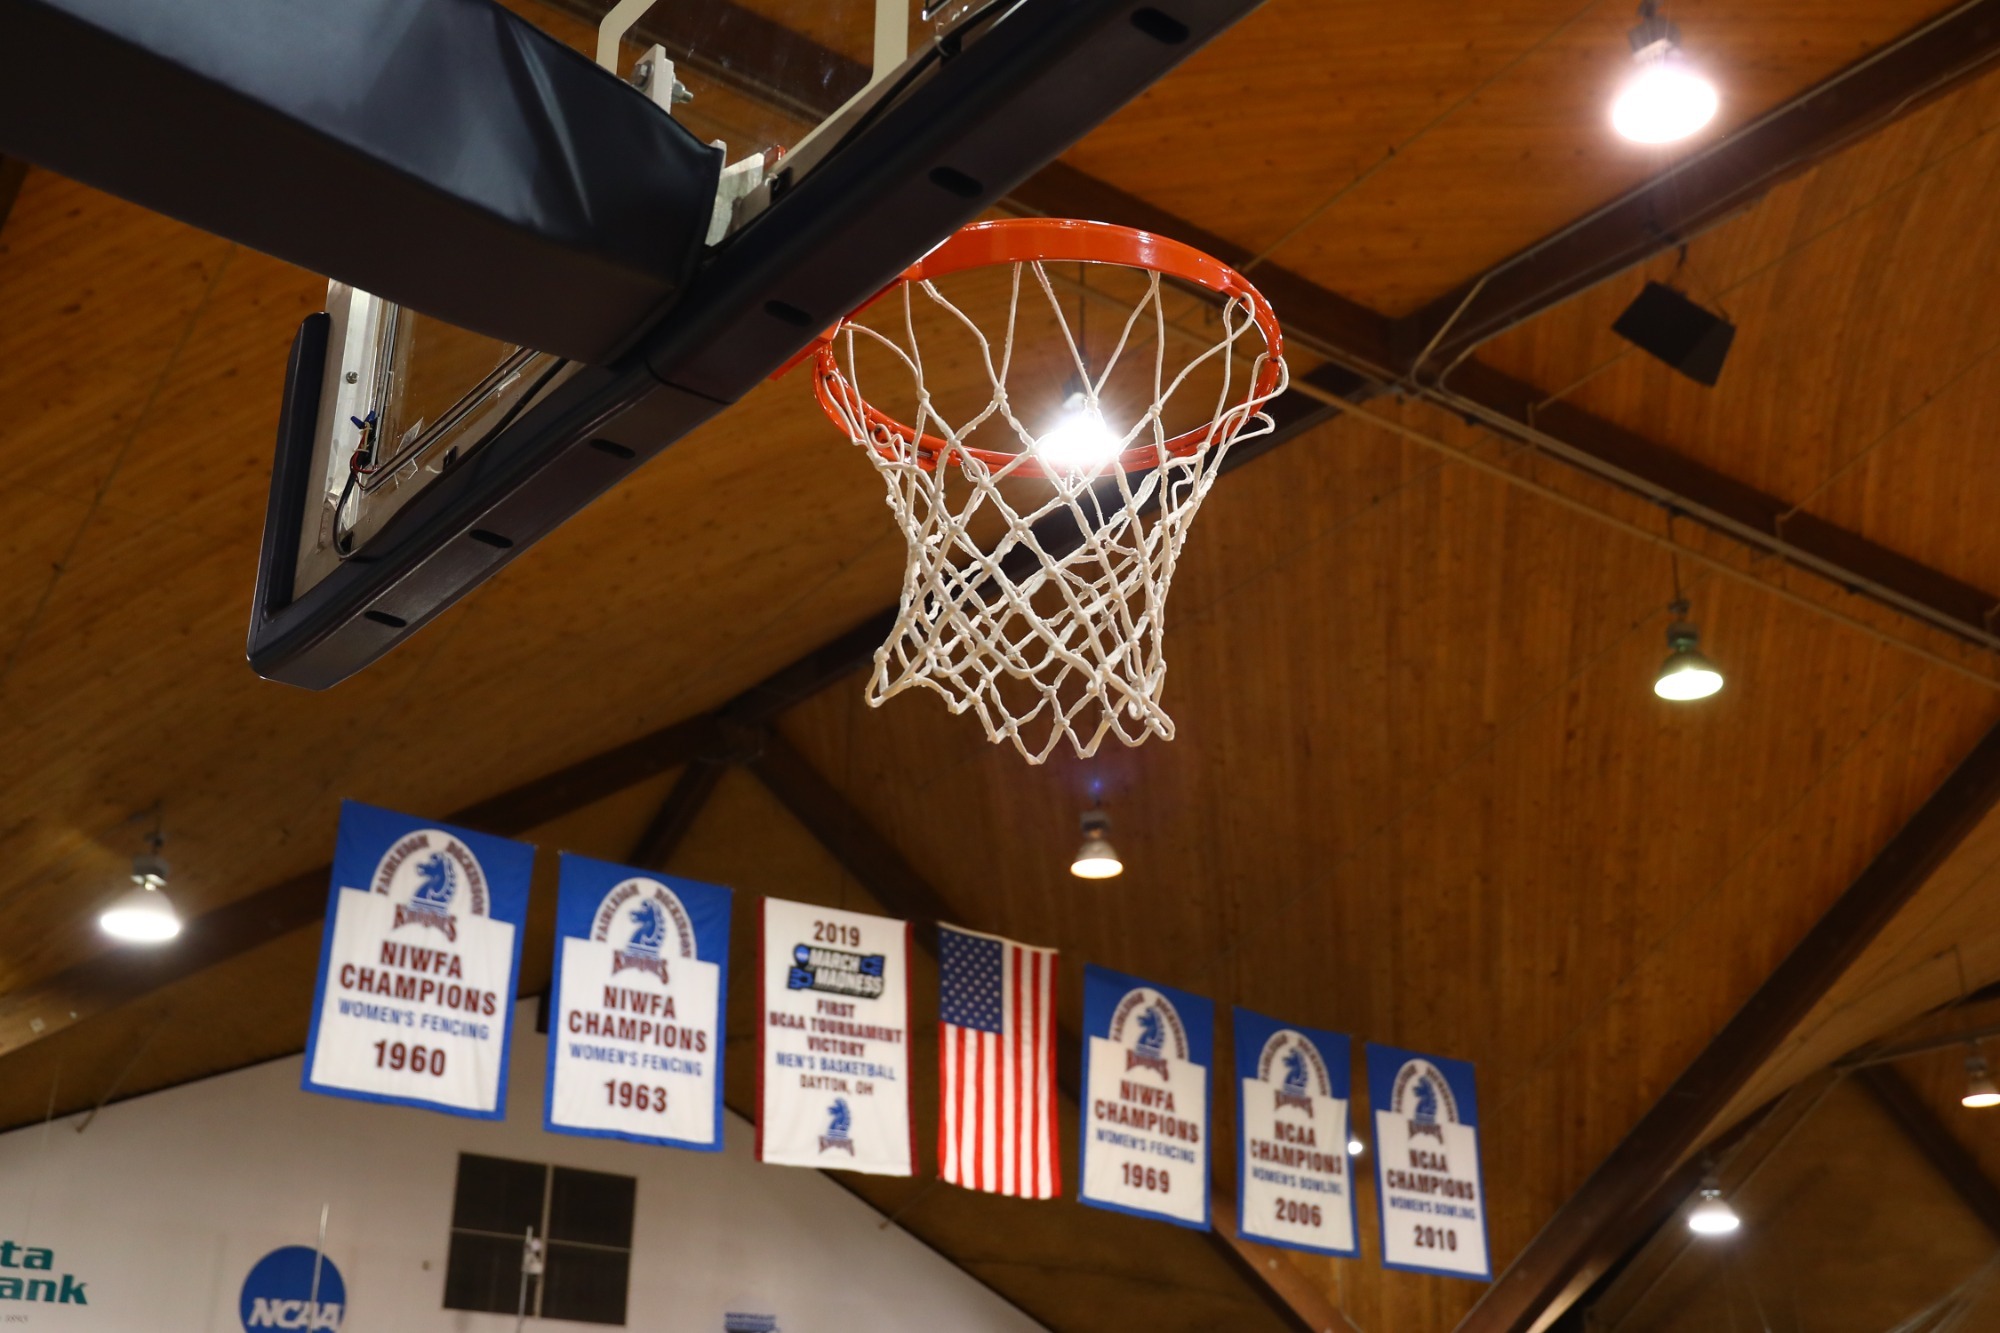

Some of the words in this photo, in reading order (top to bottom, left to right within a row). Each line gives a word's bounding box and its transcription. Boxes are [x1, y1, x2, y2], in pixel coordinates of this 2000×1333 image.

[813, 920, 860, 947] 2019
[380, 941, 463, 979] NIWFA
[809, 948, 861, 974] MARCH
[340, 964, 497, 1017] CHAMPIONS
[814, 968, 883, 994] MADNESS
[603, 985, 676, 1019] NIWFA
[817, 999, 856, 1018] FIRST
[338, 998, 415, 1027] WOMEN'S
[420, 1013, 489, 1040] FENCING
[568, 1010, 707, 1053] CHAMPIONS
[769, 1011, 806, 1031] NCAA
[810, 1017, 902, 1043] TOURNAMENT
[374, 1039, 446, 1078] 1960
[569, 1043, 638, 1067] WOMEN'S
[642, 1055, 703, 1077] FENCING
[807, 1035, 865, 1058] VICTORY
[776, 1051, 815, 1069] MEN'S
[820, 1056, 896, 1081] BASKETBALL
[604, 1079, 667, 1114] 1963
[800, 1074, 851, 1095] DAYTON,
[855, 1081, 874, 1096] OH
[1119, 1080, 1175, 1113] NIWFA
[1094, 1099, 1199, 1144] CHAMPIONS
[1274, 1121, 1316, 1147] NCAA
[1096, 1128, 1147, 1152] WOMEN'S
[1150, 1141, 1195, 1164] FENCING
[1250, 1139, 1342, 1175] CHAMPIONS
[1408, 1148, 1448, 1173] NCAA
[1121, 1162, 1170, 1194] 1969
[1252, 1166, 1298, 1188] WOMEN'S
[1300, 1175, 1344, 1195] BOWLING
[1386, 1169, 1474, 1201] CHAMPIONS
[1275, 1197, 1321, 1227] 2006
[1389, 1196, 1432, 1215] WOMEN'S
[1434, 1202, 1476, 1220] BOWLING
[1413, 1224, 1457, 1252] 2010
[247, 1297, 342, 1332] NCAA
